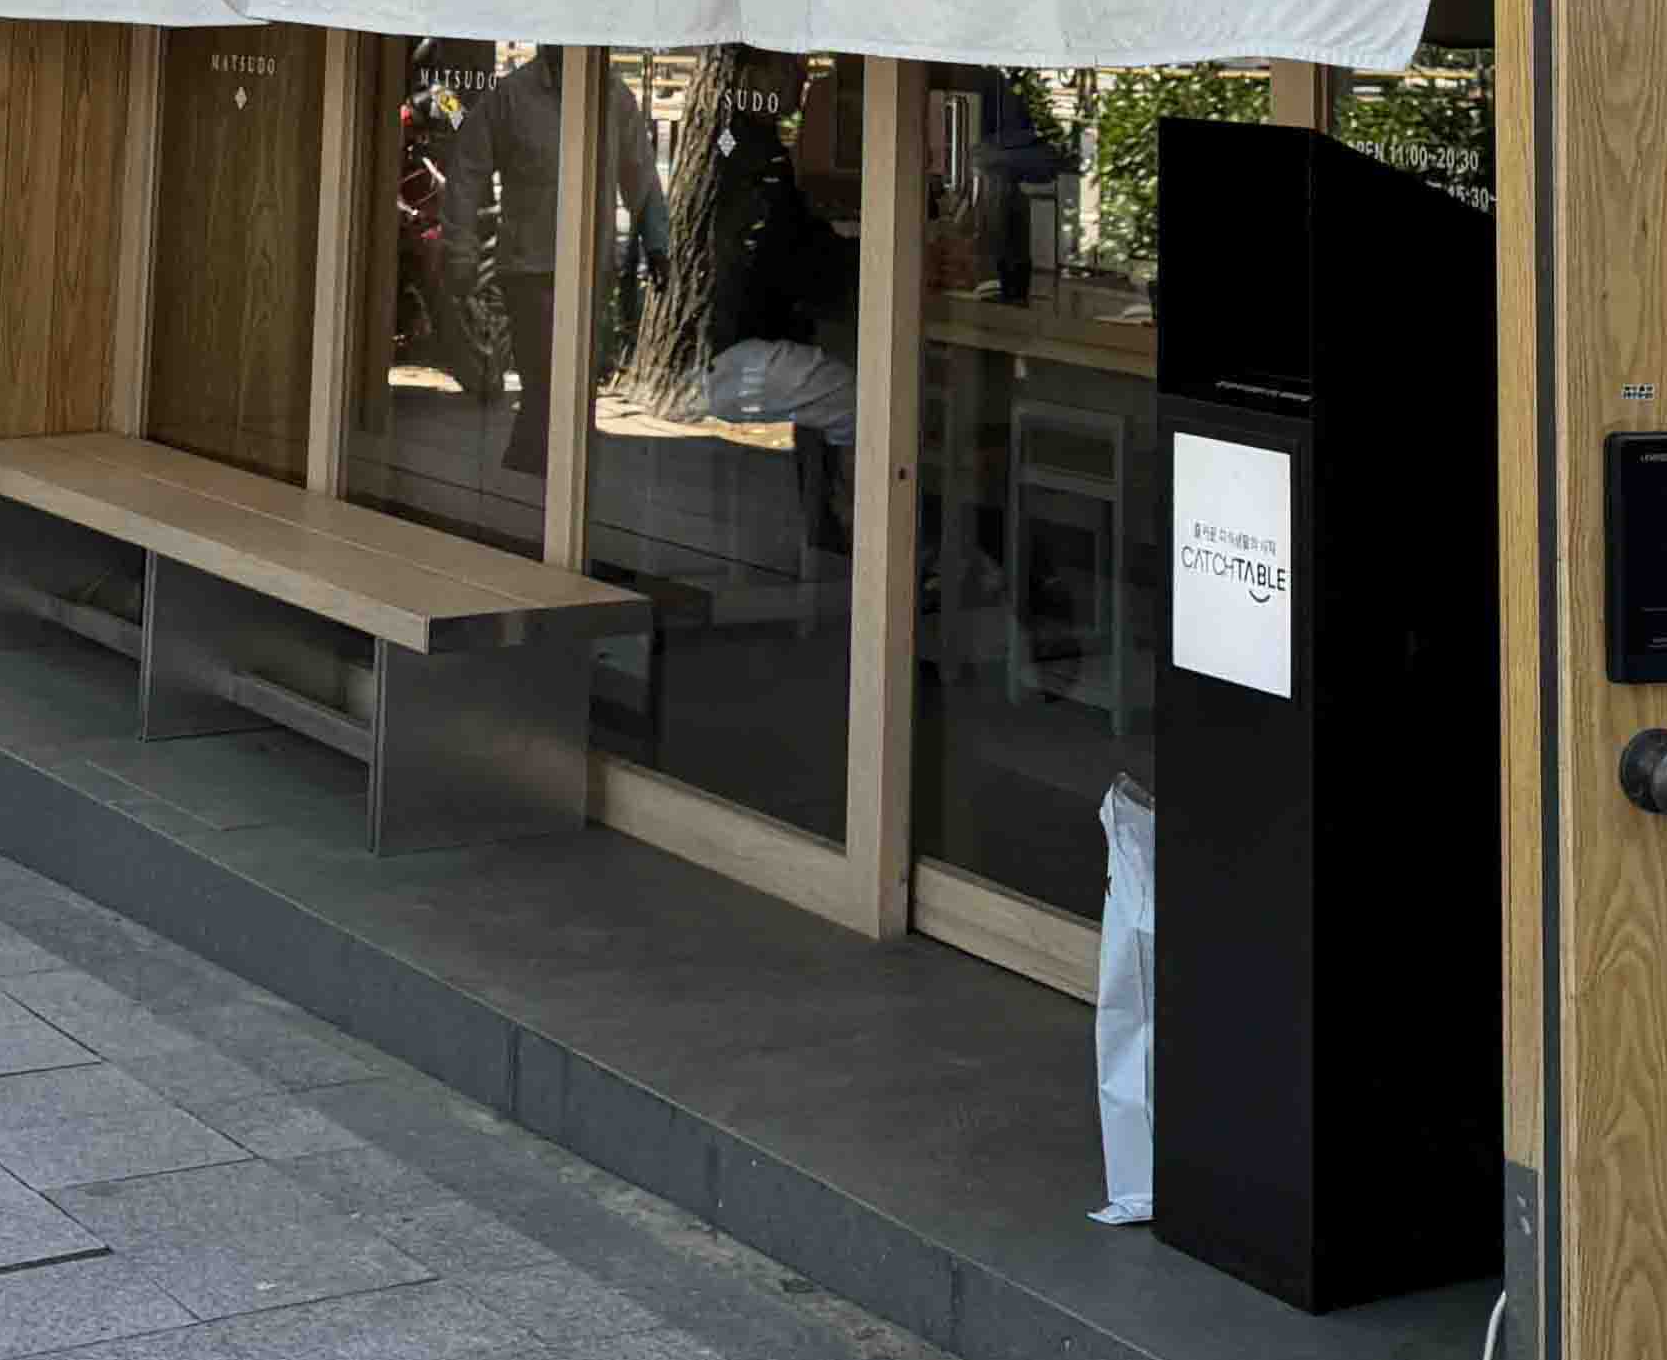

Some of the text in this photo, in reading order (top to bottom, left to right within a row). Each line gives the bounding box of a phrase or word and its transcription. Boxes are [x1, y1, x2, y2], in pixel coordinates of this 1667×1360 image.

[212, 54, 276, 75] MATSUDO
[420, 68, 498, 91] MATSUDO
[1181, 544, 1287, 592] CATCHTABLE
